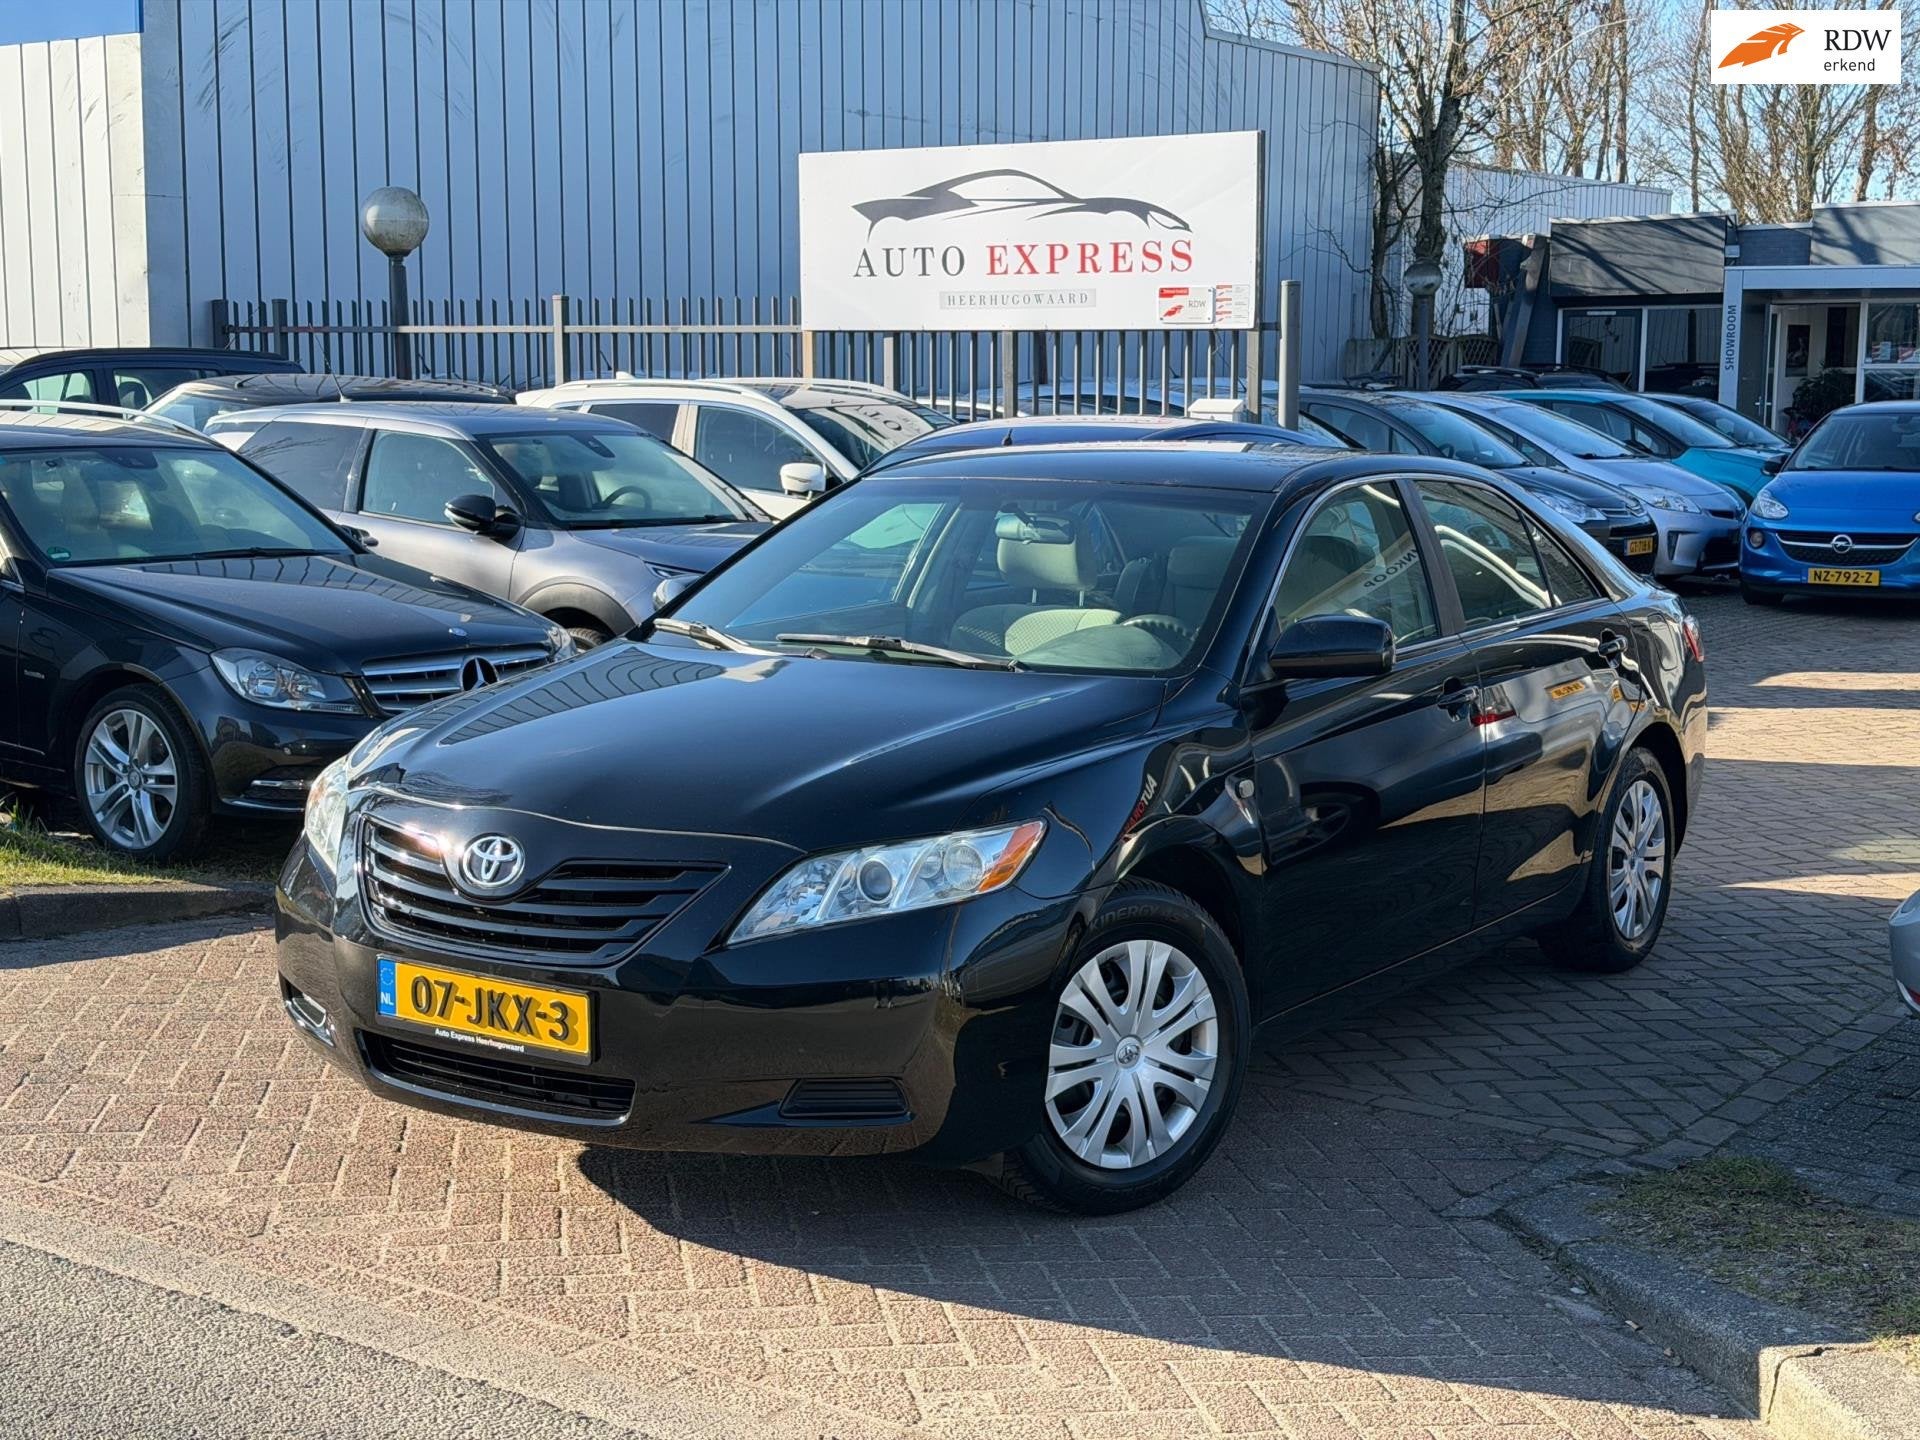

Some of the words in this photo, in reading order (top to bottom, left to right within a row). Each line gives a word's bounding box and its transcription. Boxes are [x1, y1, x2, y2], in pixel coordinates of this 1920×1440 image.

[853, 246, 965, 277] AUTO
[985, 239, 1193, 276] EXPRESS
[947, 291, 1089, 307] HEERHUGOWAARD
[1188, 299, 1207, 308] RDW
[1724, 304, 1737, 371] SHOWROOM
[1813, 570, 1873, 584] NZ-792-Z
[380, 991, 394, 1006] NL
[411, 975, 570, 1041] 07-JKX-3
[434, 1027, 450, 1038] Auto
[450, 1031, 475, 1042] Express
